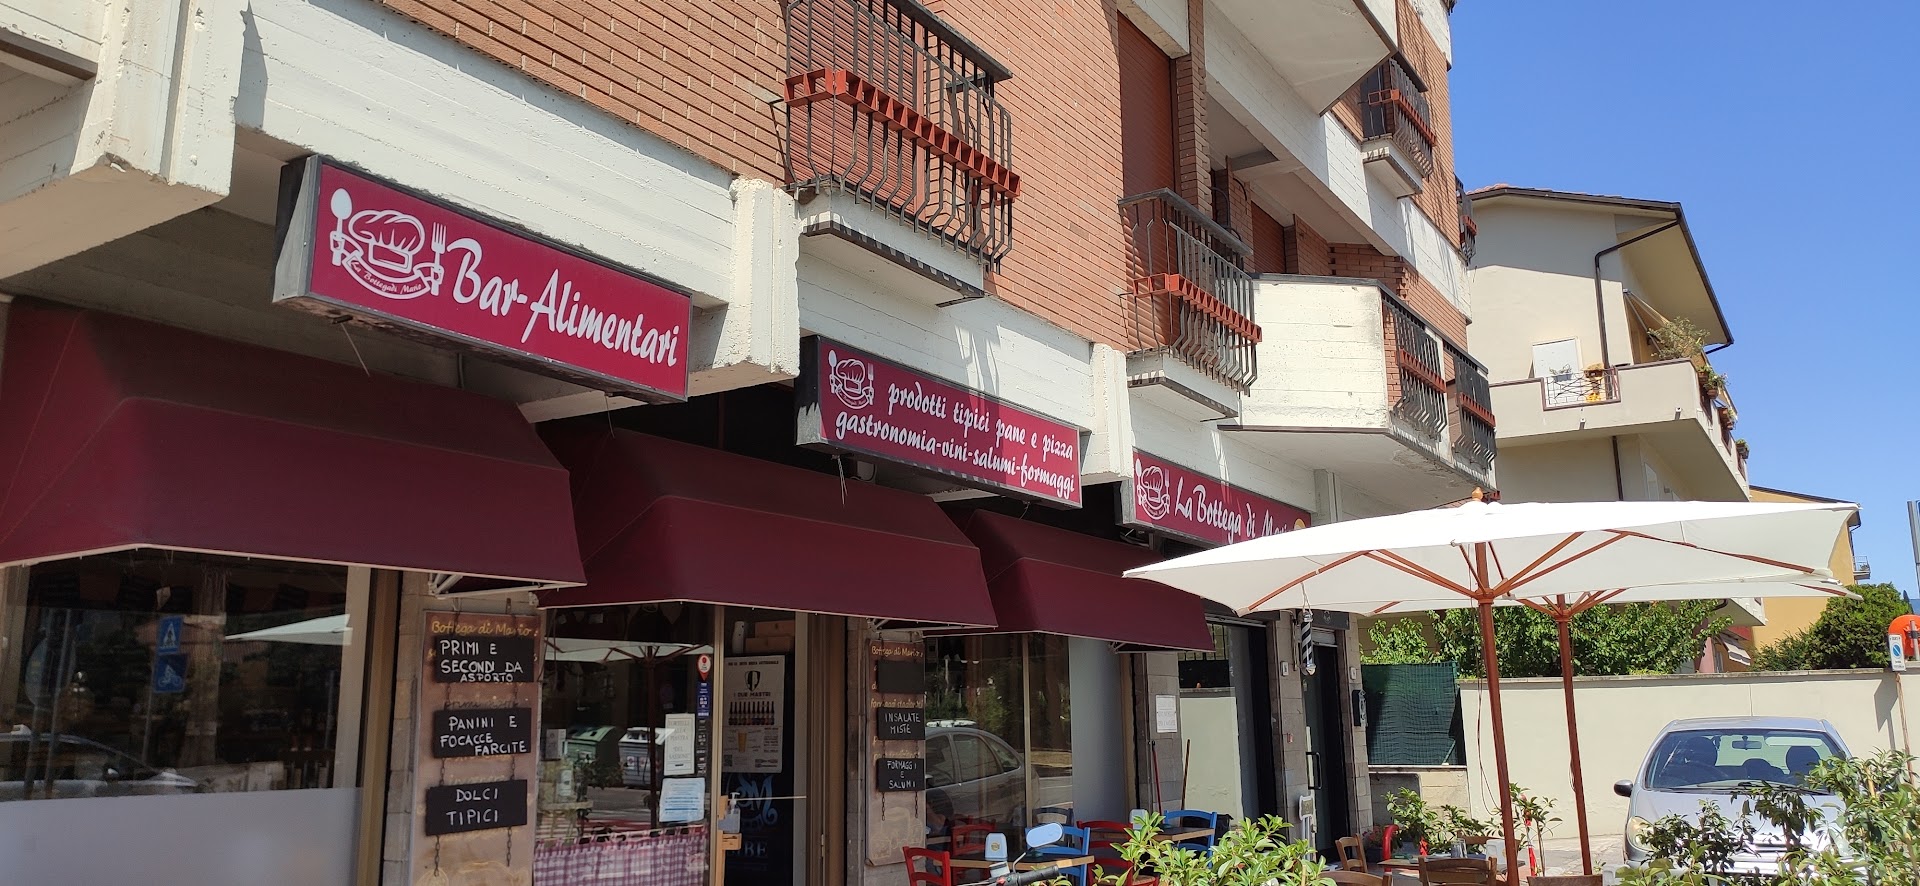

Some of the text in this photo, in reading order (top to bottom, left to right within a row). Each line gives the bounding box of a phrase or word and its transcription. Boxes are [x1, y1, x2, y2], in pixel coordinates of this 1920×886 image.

[351, 261, 362, 273] La
[399, 283, 422, 294] Mario
[447, 237, 680, 367] Bar-Alimentari
[887, 381, 947, 419] prodotti
[952, 401, 990, 437] tipici
[995, 418, 1027, 448] pane
[1030, 431, 1038, 449] e
[1041, 434, 1074, 461] pizza
[1174, 476, 1193, 521] La
[1192, 484, 1242, 545] Bottega
[1246, 502, 1256, 538] di
[439, 639, 480, 656] PRIMI
[489, 643, 498, 655] E
[440, 659, 524, 674] SECONDI DA
[459, 672, 514, 683] ASPORTO
[448, 715, 518, 732] PANINI E
[884, 712, 921, 723] INSALATE
[890, 724, 911, 735] MISTE
[440, 732, 493, 748] FOCACCE
[474, 740, 527, 757] FARCITE
[887, 760, 917, 770] FORMAGGI
[888, 780, 917, 789] SALUMI
[455, 787, 499, 803] DOLCI
[445, 808, 499, 826] TIPICI
